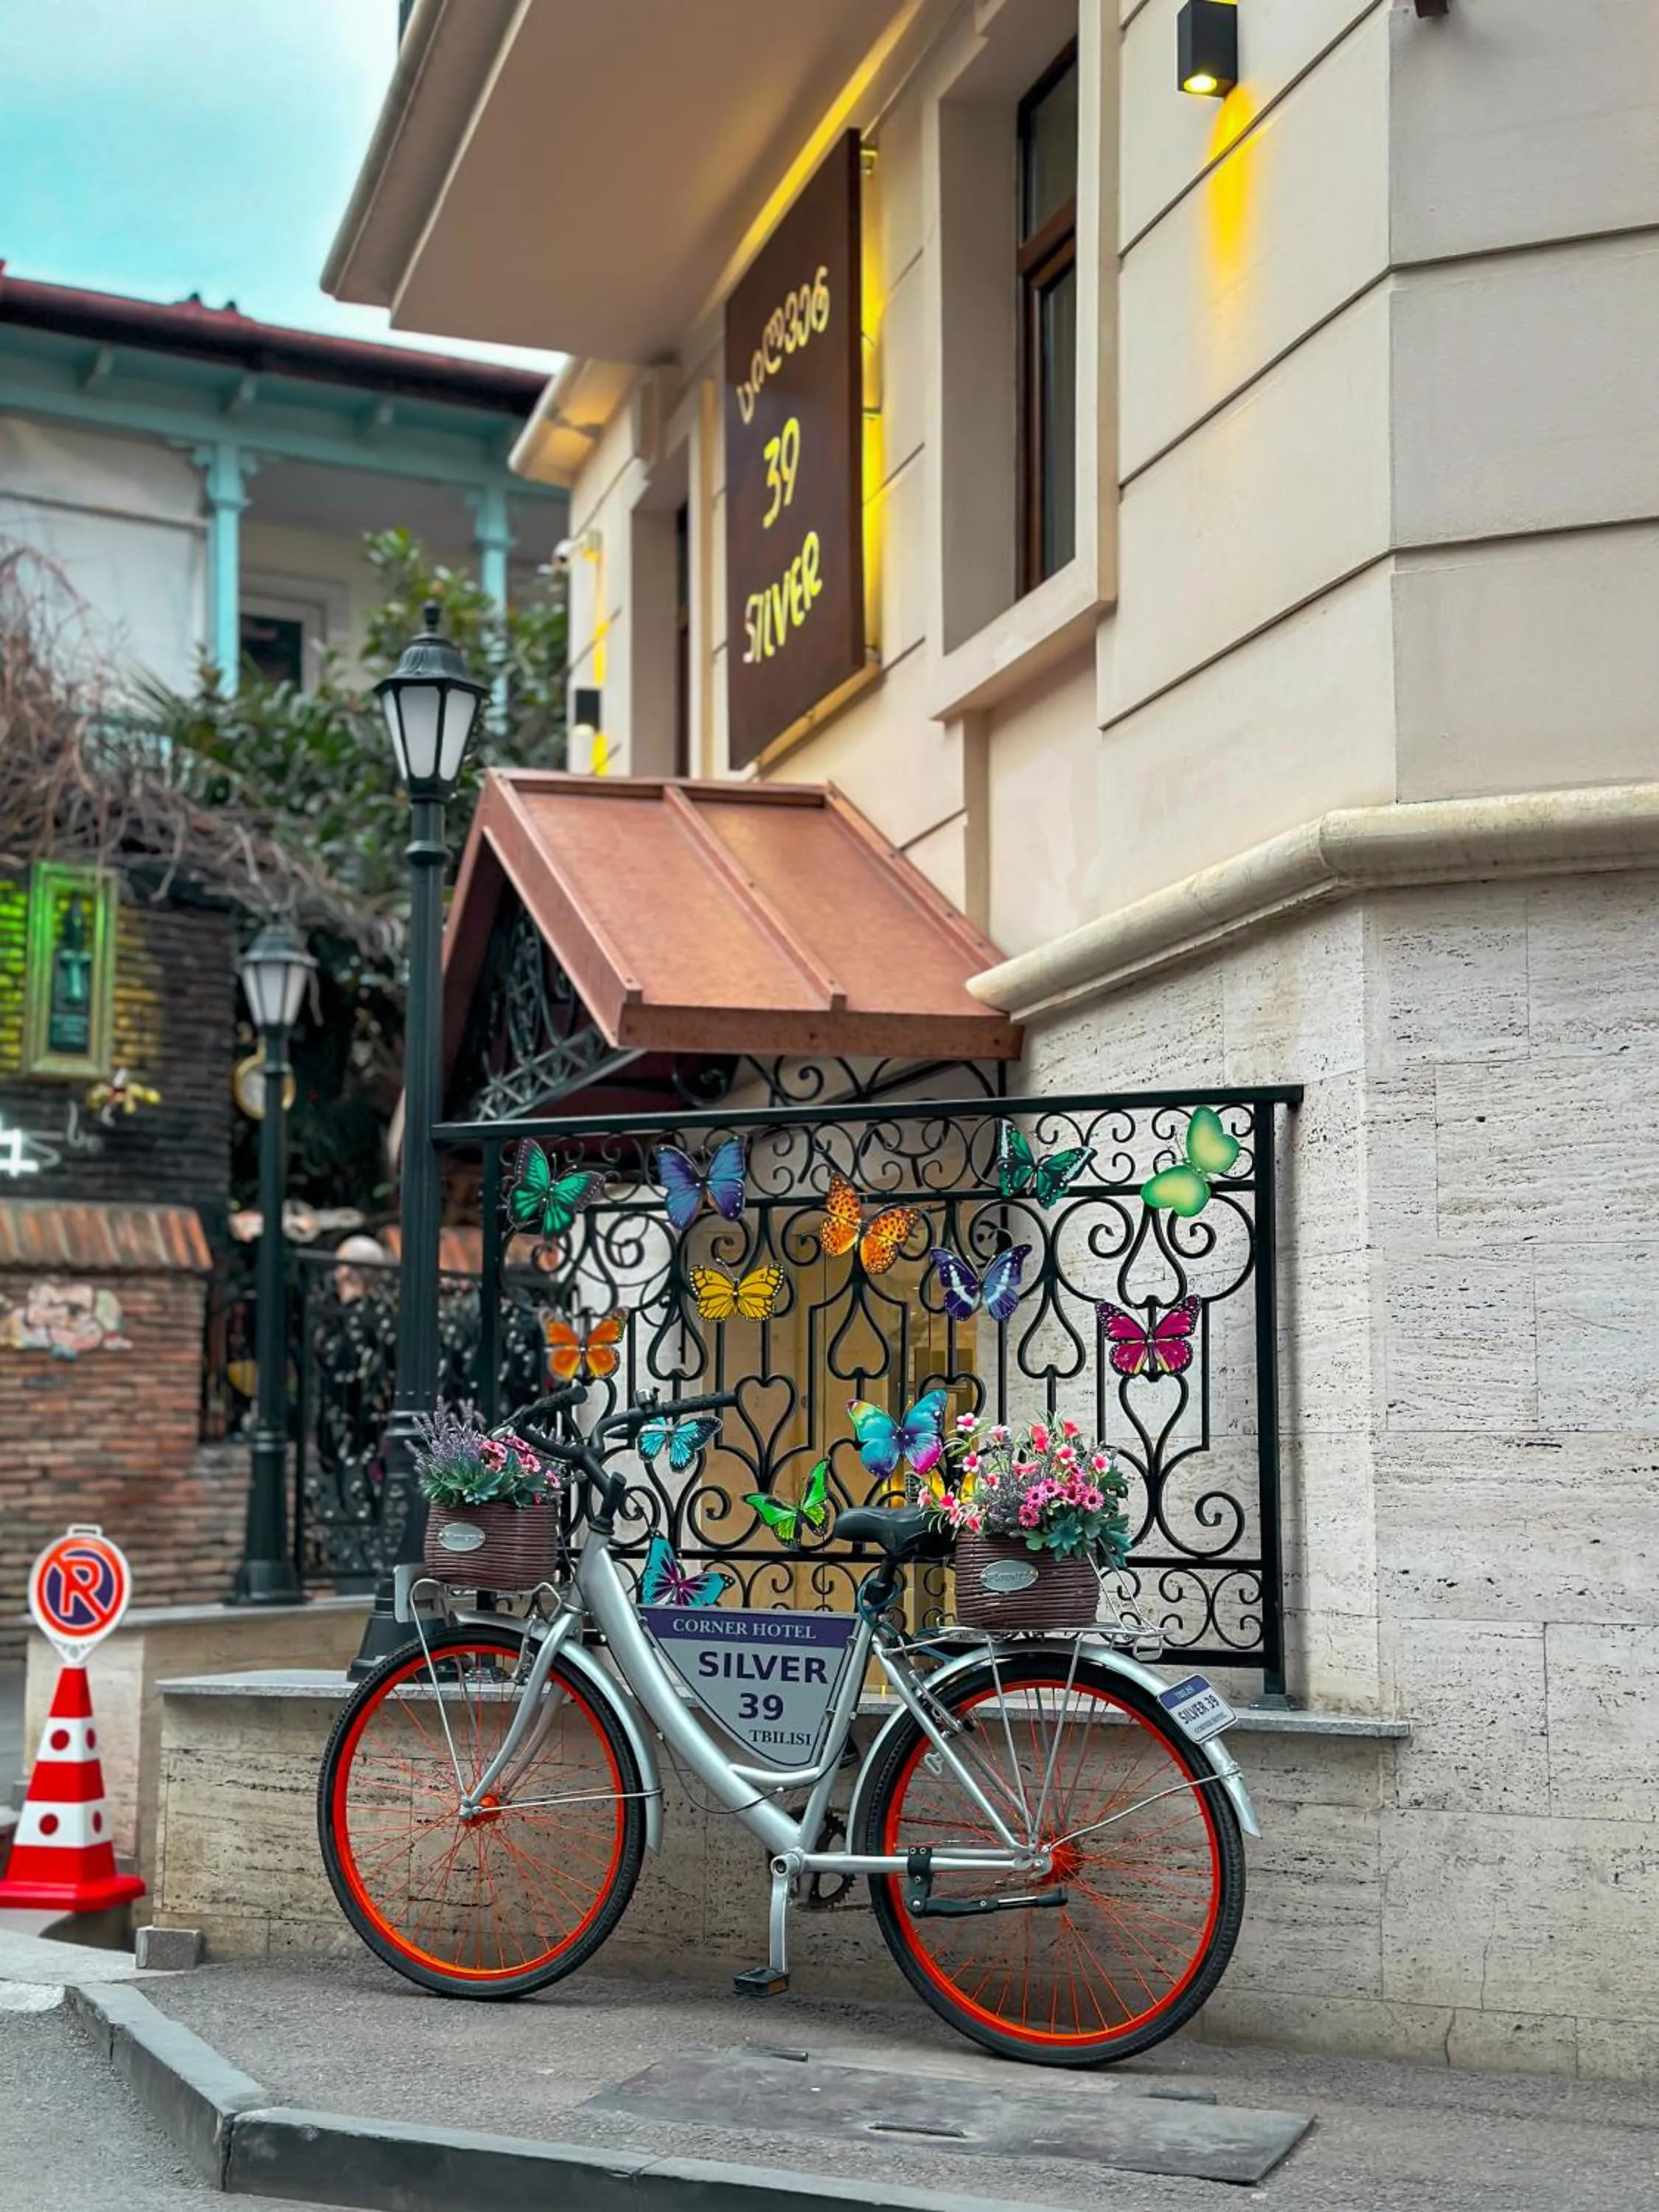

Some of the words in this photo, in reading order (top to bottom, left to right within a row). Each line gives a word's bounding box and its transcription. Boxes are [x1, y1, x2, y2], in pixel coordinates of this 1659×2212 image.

[762, 417, 801, 529] 39
[743, 531, 823, 664] SILVER
[672, 1618, 748, 1635] CORNER
[752, 1622, 817, 1639] HOTEL
[698, 1651, 829, 1685] SILVER
[737, 1692, 785, 1721] 39
[1178, 1700, 1210, 1725] SILVER
[1203, 1694, 1220, 1709] 39
[748, 1728, 813, 1747] TBILISI
